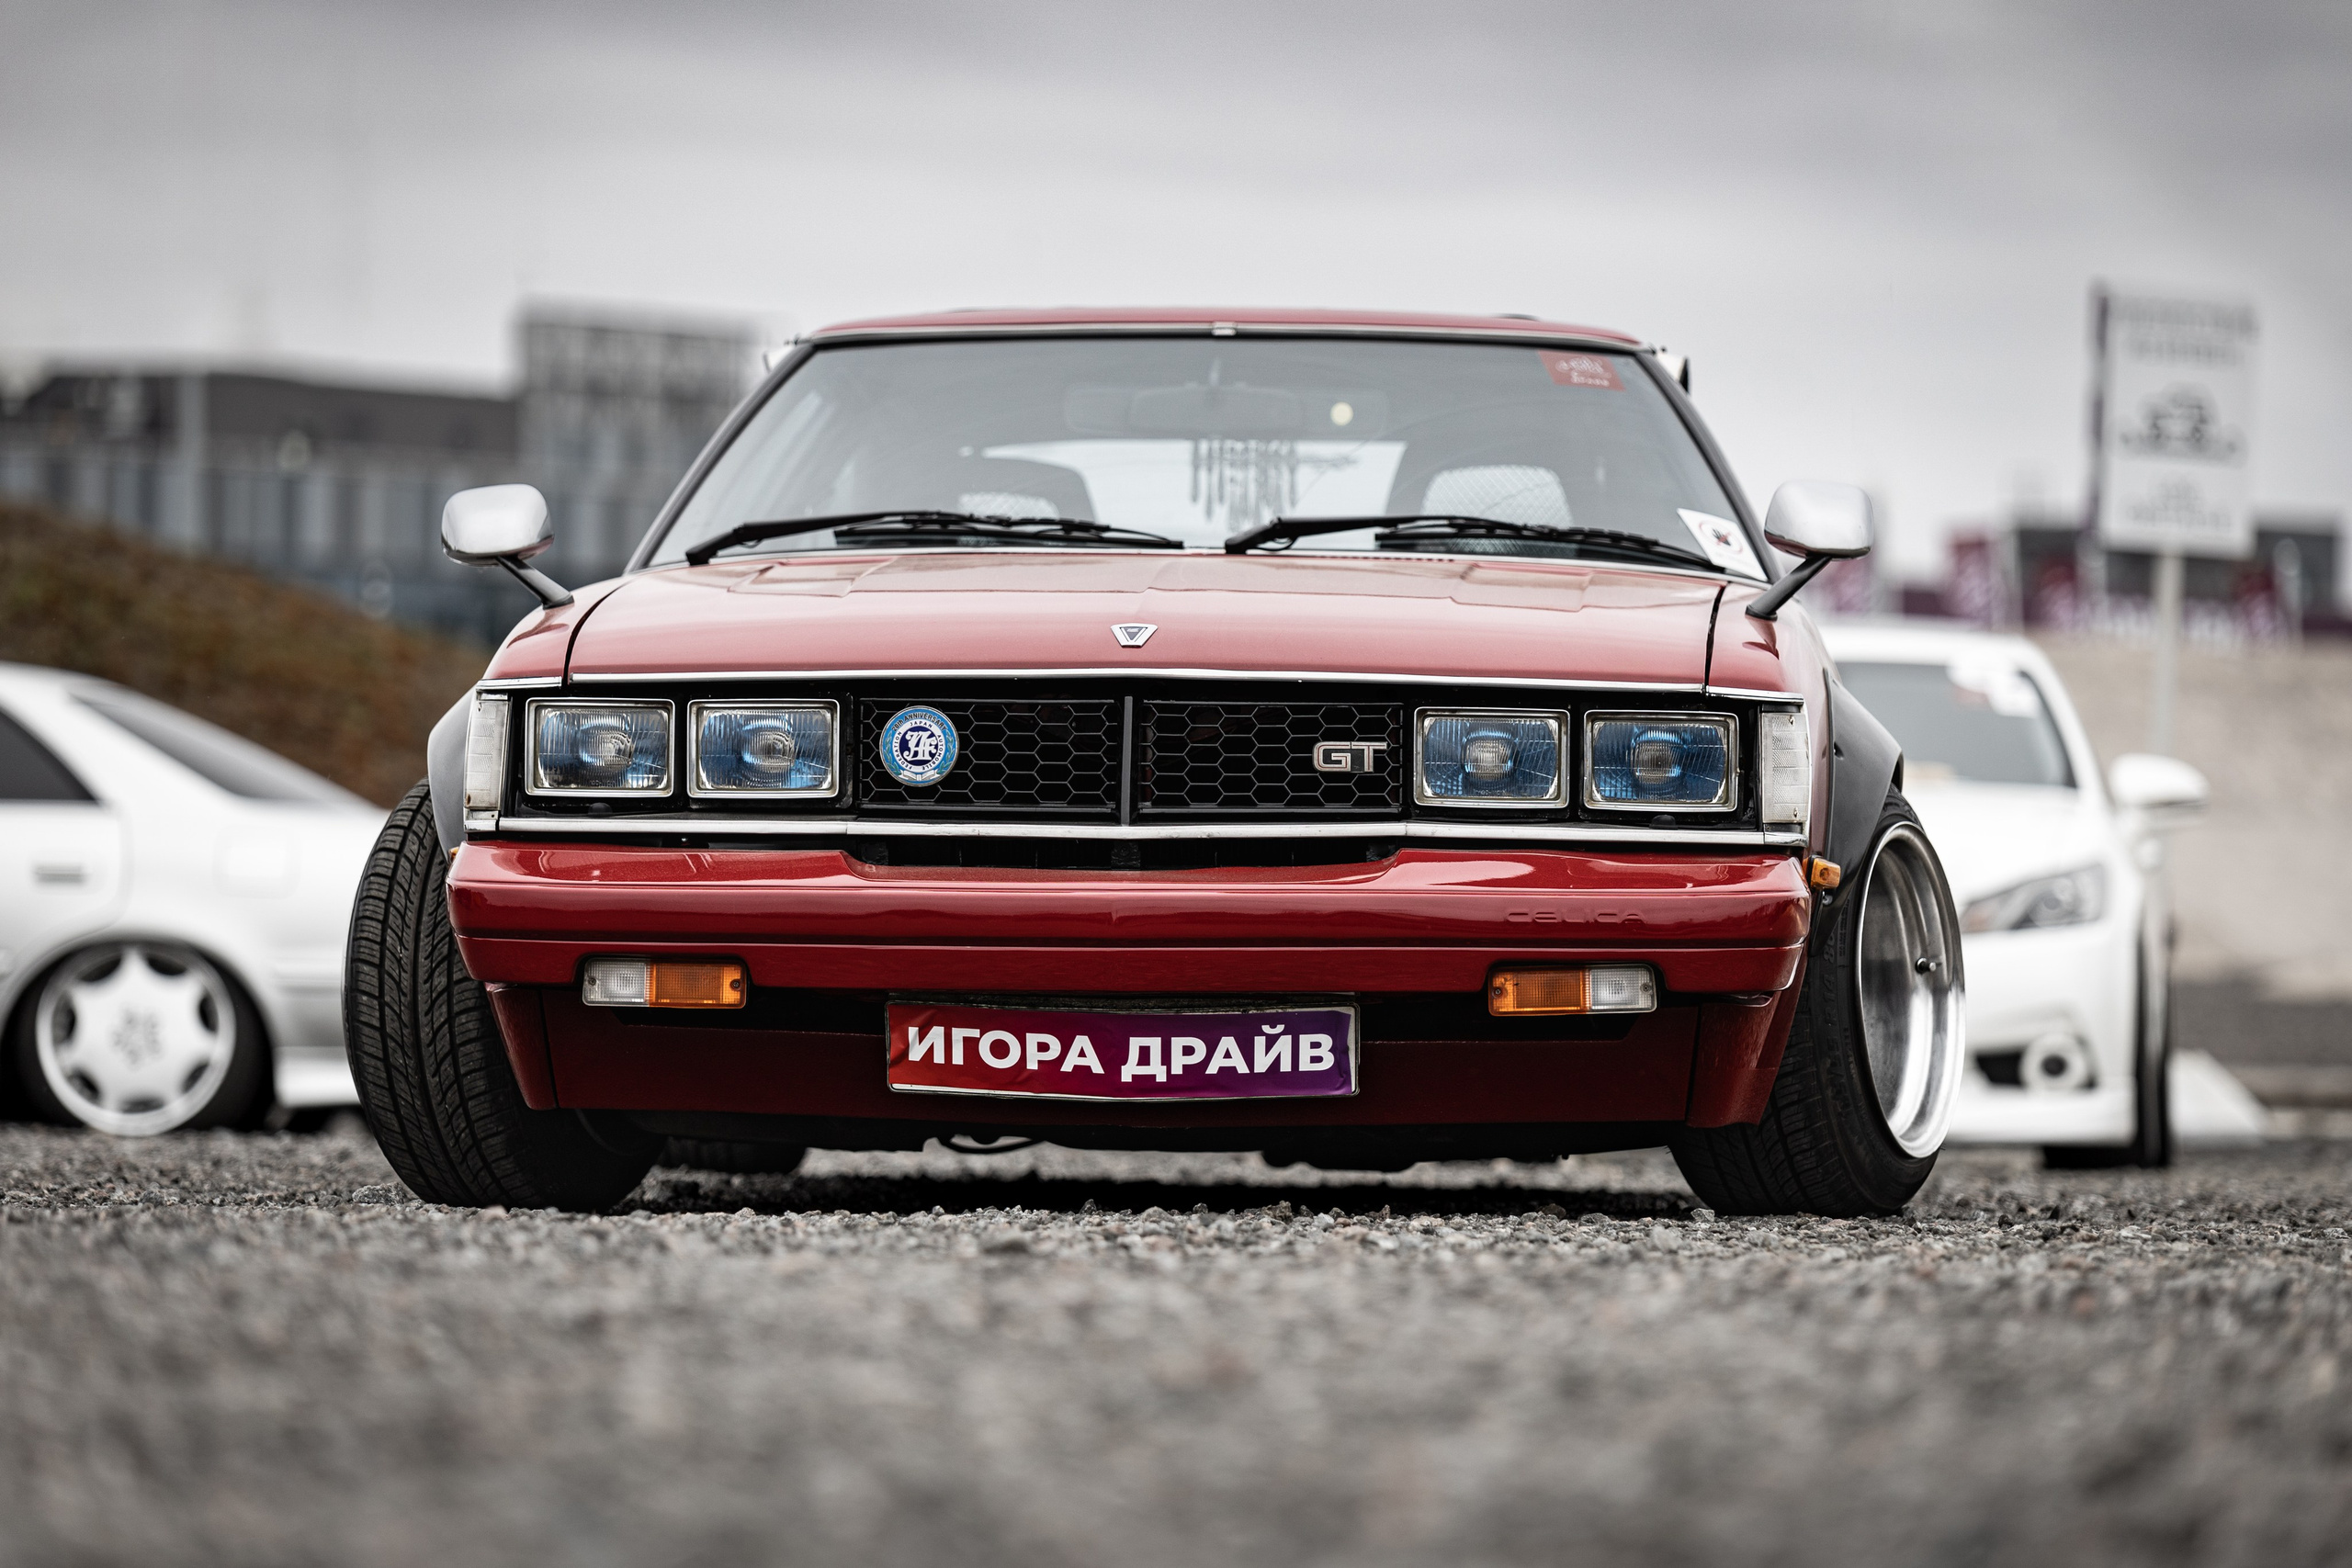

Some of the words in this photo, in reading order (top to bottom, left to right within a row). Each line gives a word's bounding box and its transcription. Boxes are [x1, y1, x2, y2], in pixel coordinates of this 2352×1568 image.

[903, 712, 948, 731] ANNIVERSARY
[910, 720, 933, 728] JAPAN
[893, 731, 912, 771] FEDERATION
[922, 734, 944, 771] AUTOMOBILE
[1313, 741, 1387, 772] GT
[908, 1025, 1104, 1074] ИГОРА
[1121, 1024, 1335, 1082] ДРАЙВ
